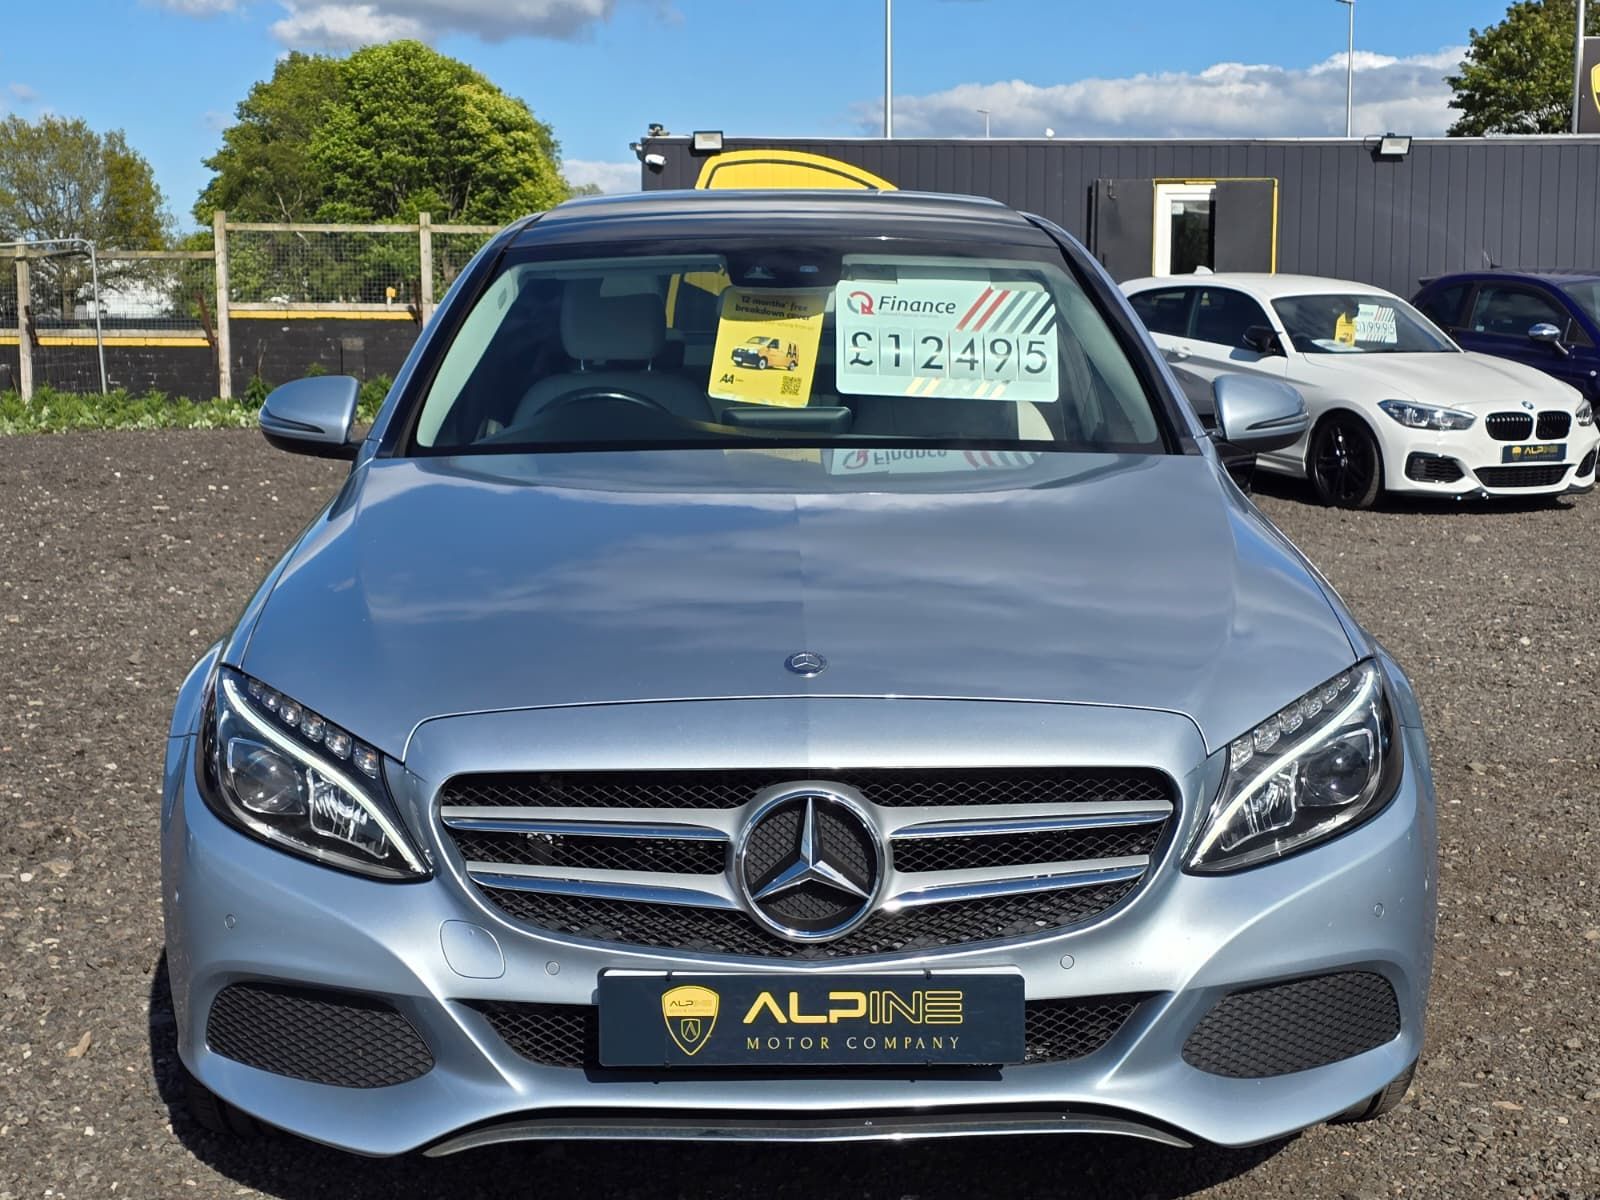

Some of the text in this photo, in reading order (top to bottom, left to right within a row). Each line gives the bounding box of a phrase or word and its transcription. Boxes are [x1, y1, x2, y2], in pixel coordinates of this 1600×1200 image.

[735, 303, 785, 317] breakdown
[878, 296, 956, 315] Finance
[786, 343, 797, 358] AA
[849, 331, 1048, 374] £12495
[719, 373, 734, 384] AA
[743, 990, 963, 1024] ALPINE
[746, 1036, 960, 1050] MOTOR COMPANY
